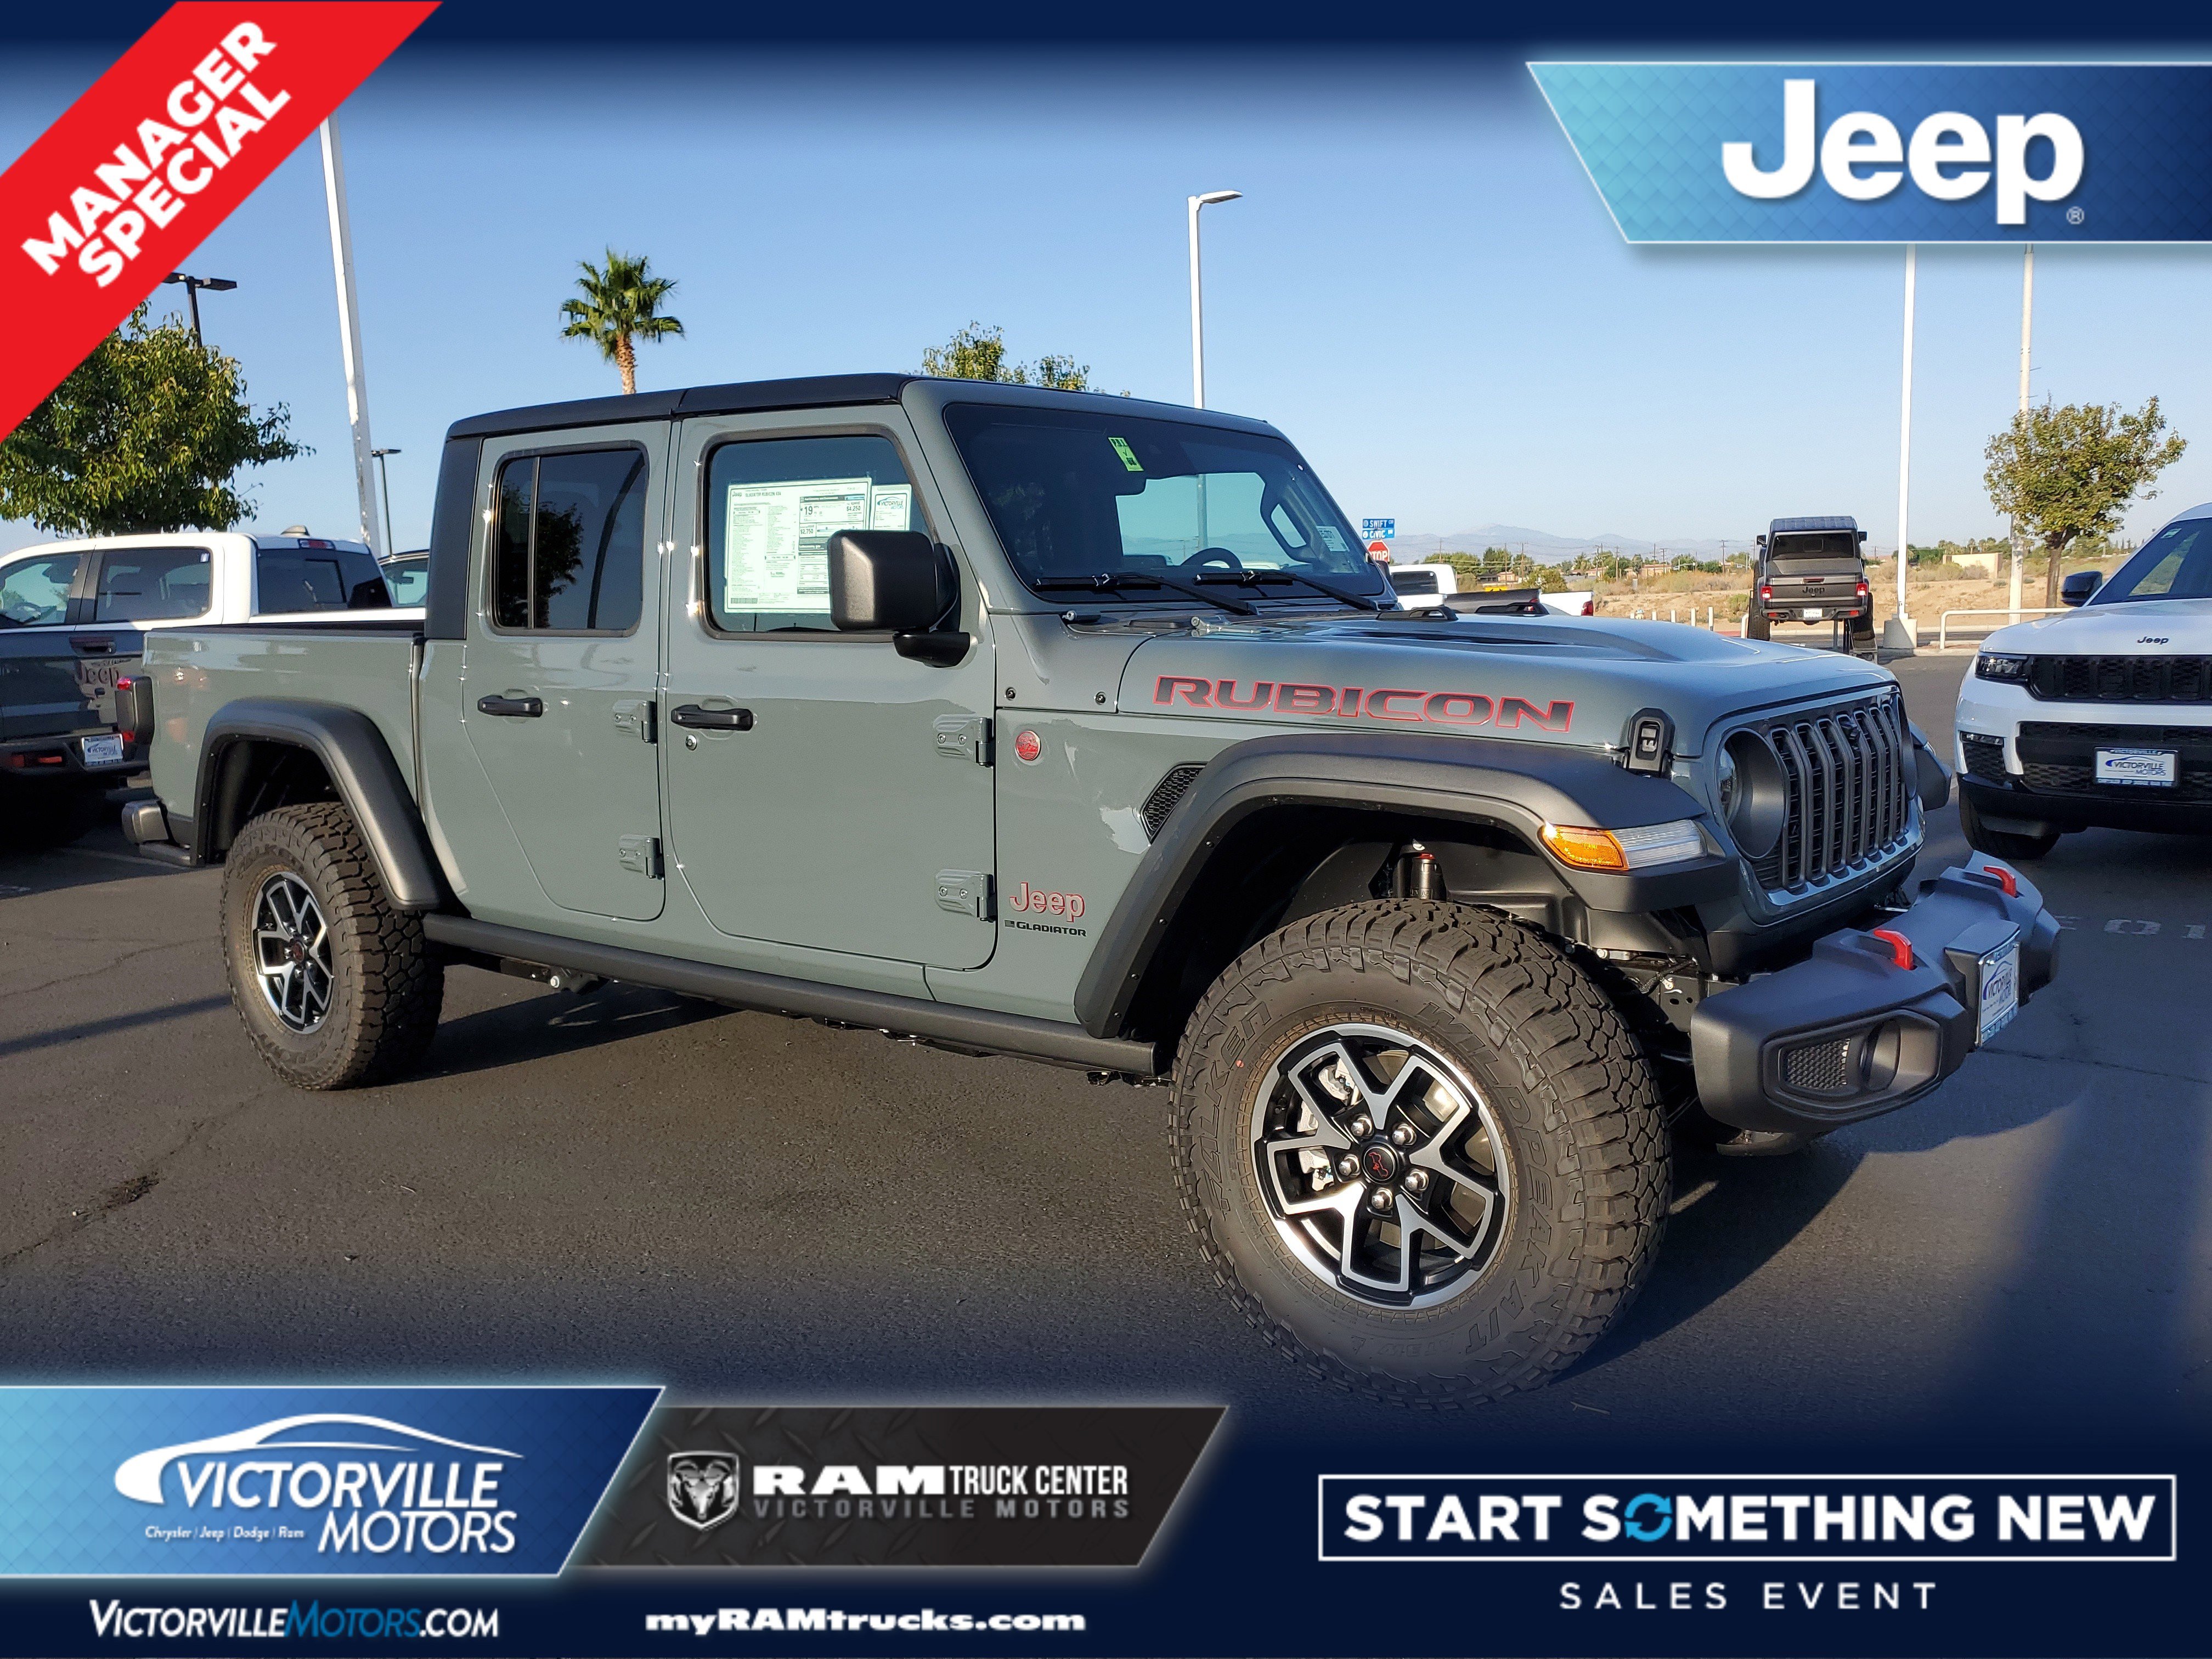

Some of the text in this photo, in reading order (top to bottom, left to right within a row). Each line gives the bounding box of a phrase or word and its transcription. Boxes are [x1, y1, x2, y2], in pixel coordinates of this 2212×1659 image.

[804, 506, 813, 515] 19
[1369, 520, 1387, 528] SWIFT
[1371, 550, 1388, 561] TOP
[2137, 636, 2169, 645] Jeep
[1153, 675, 1575, 733] RUBICON
[2114, 761, 2165, 770] VICTORVILLE
[1009, 882, 1085, 923] Jeep
[1016, 921, 1087, 937] GLADIATOR
[1199, 1001, 1272, 1222] FALKEN
